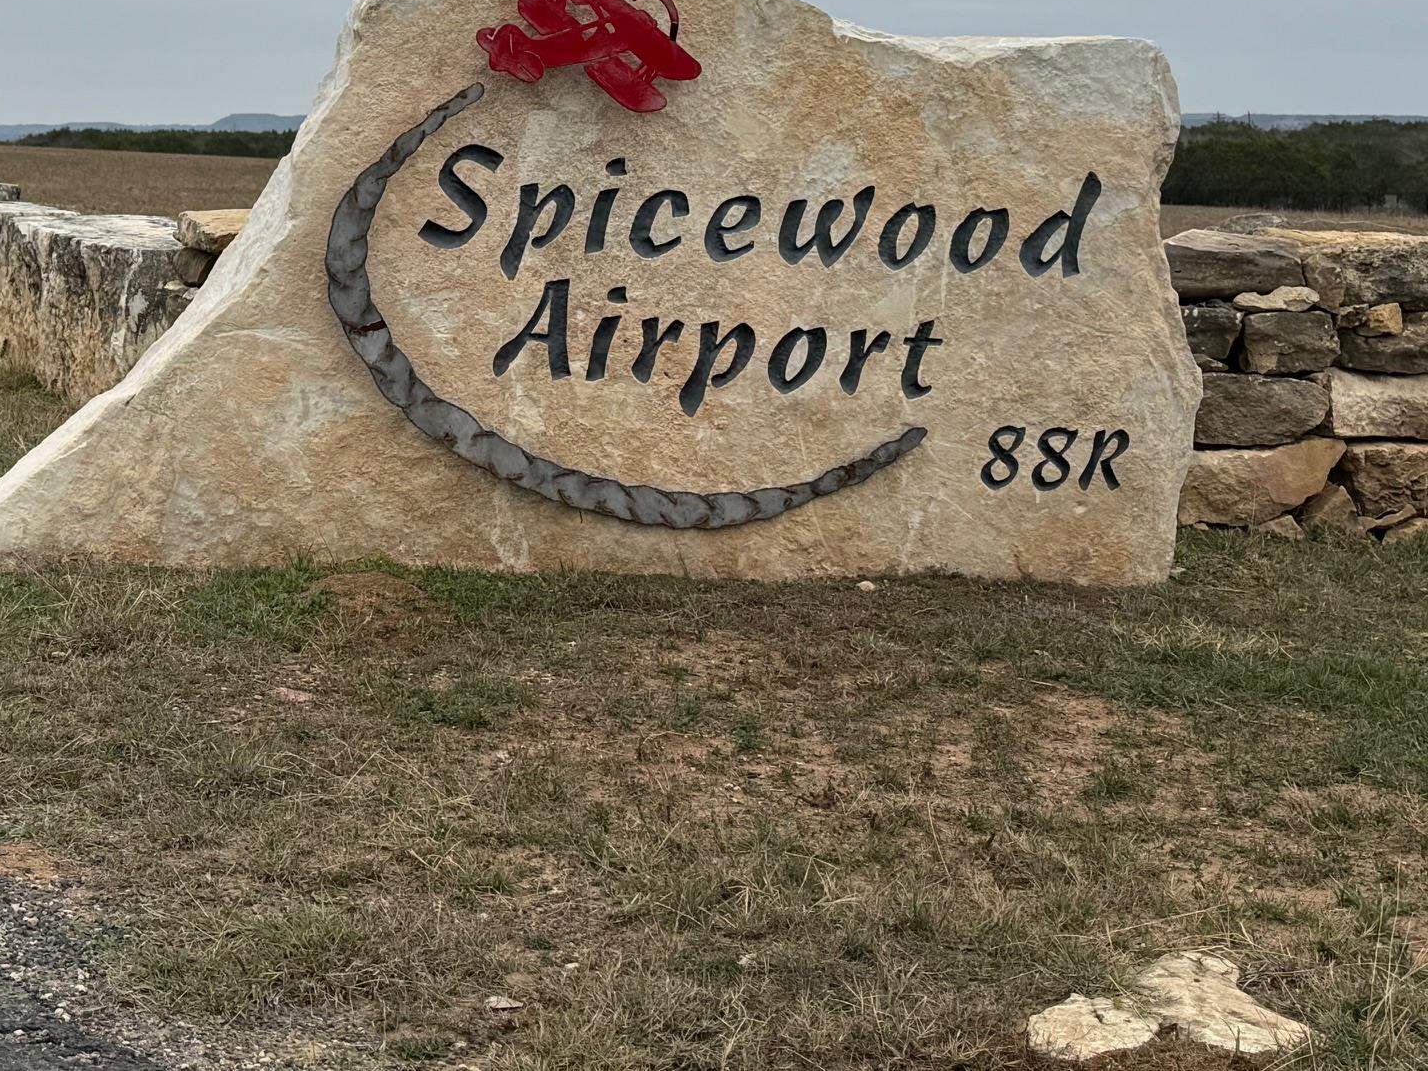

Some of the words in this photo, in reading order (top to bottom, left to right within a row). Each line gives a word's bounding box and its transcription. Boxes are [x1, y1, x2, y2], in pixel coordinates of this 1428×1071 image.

[417, 143, 1102, 280] Spicewood
[492, 278, 943, 417] Airport
[979, 424, 1131, 492] 88R
